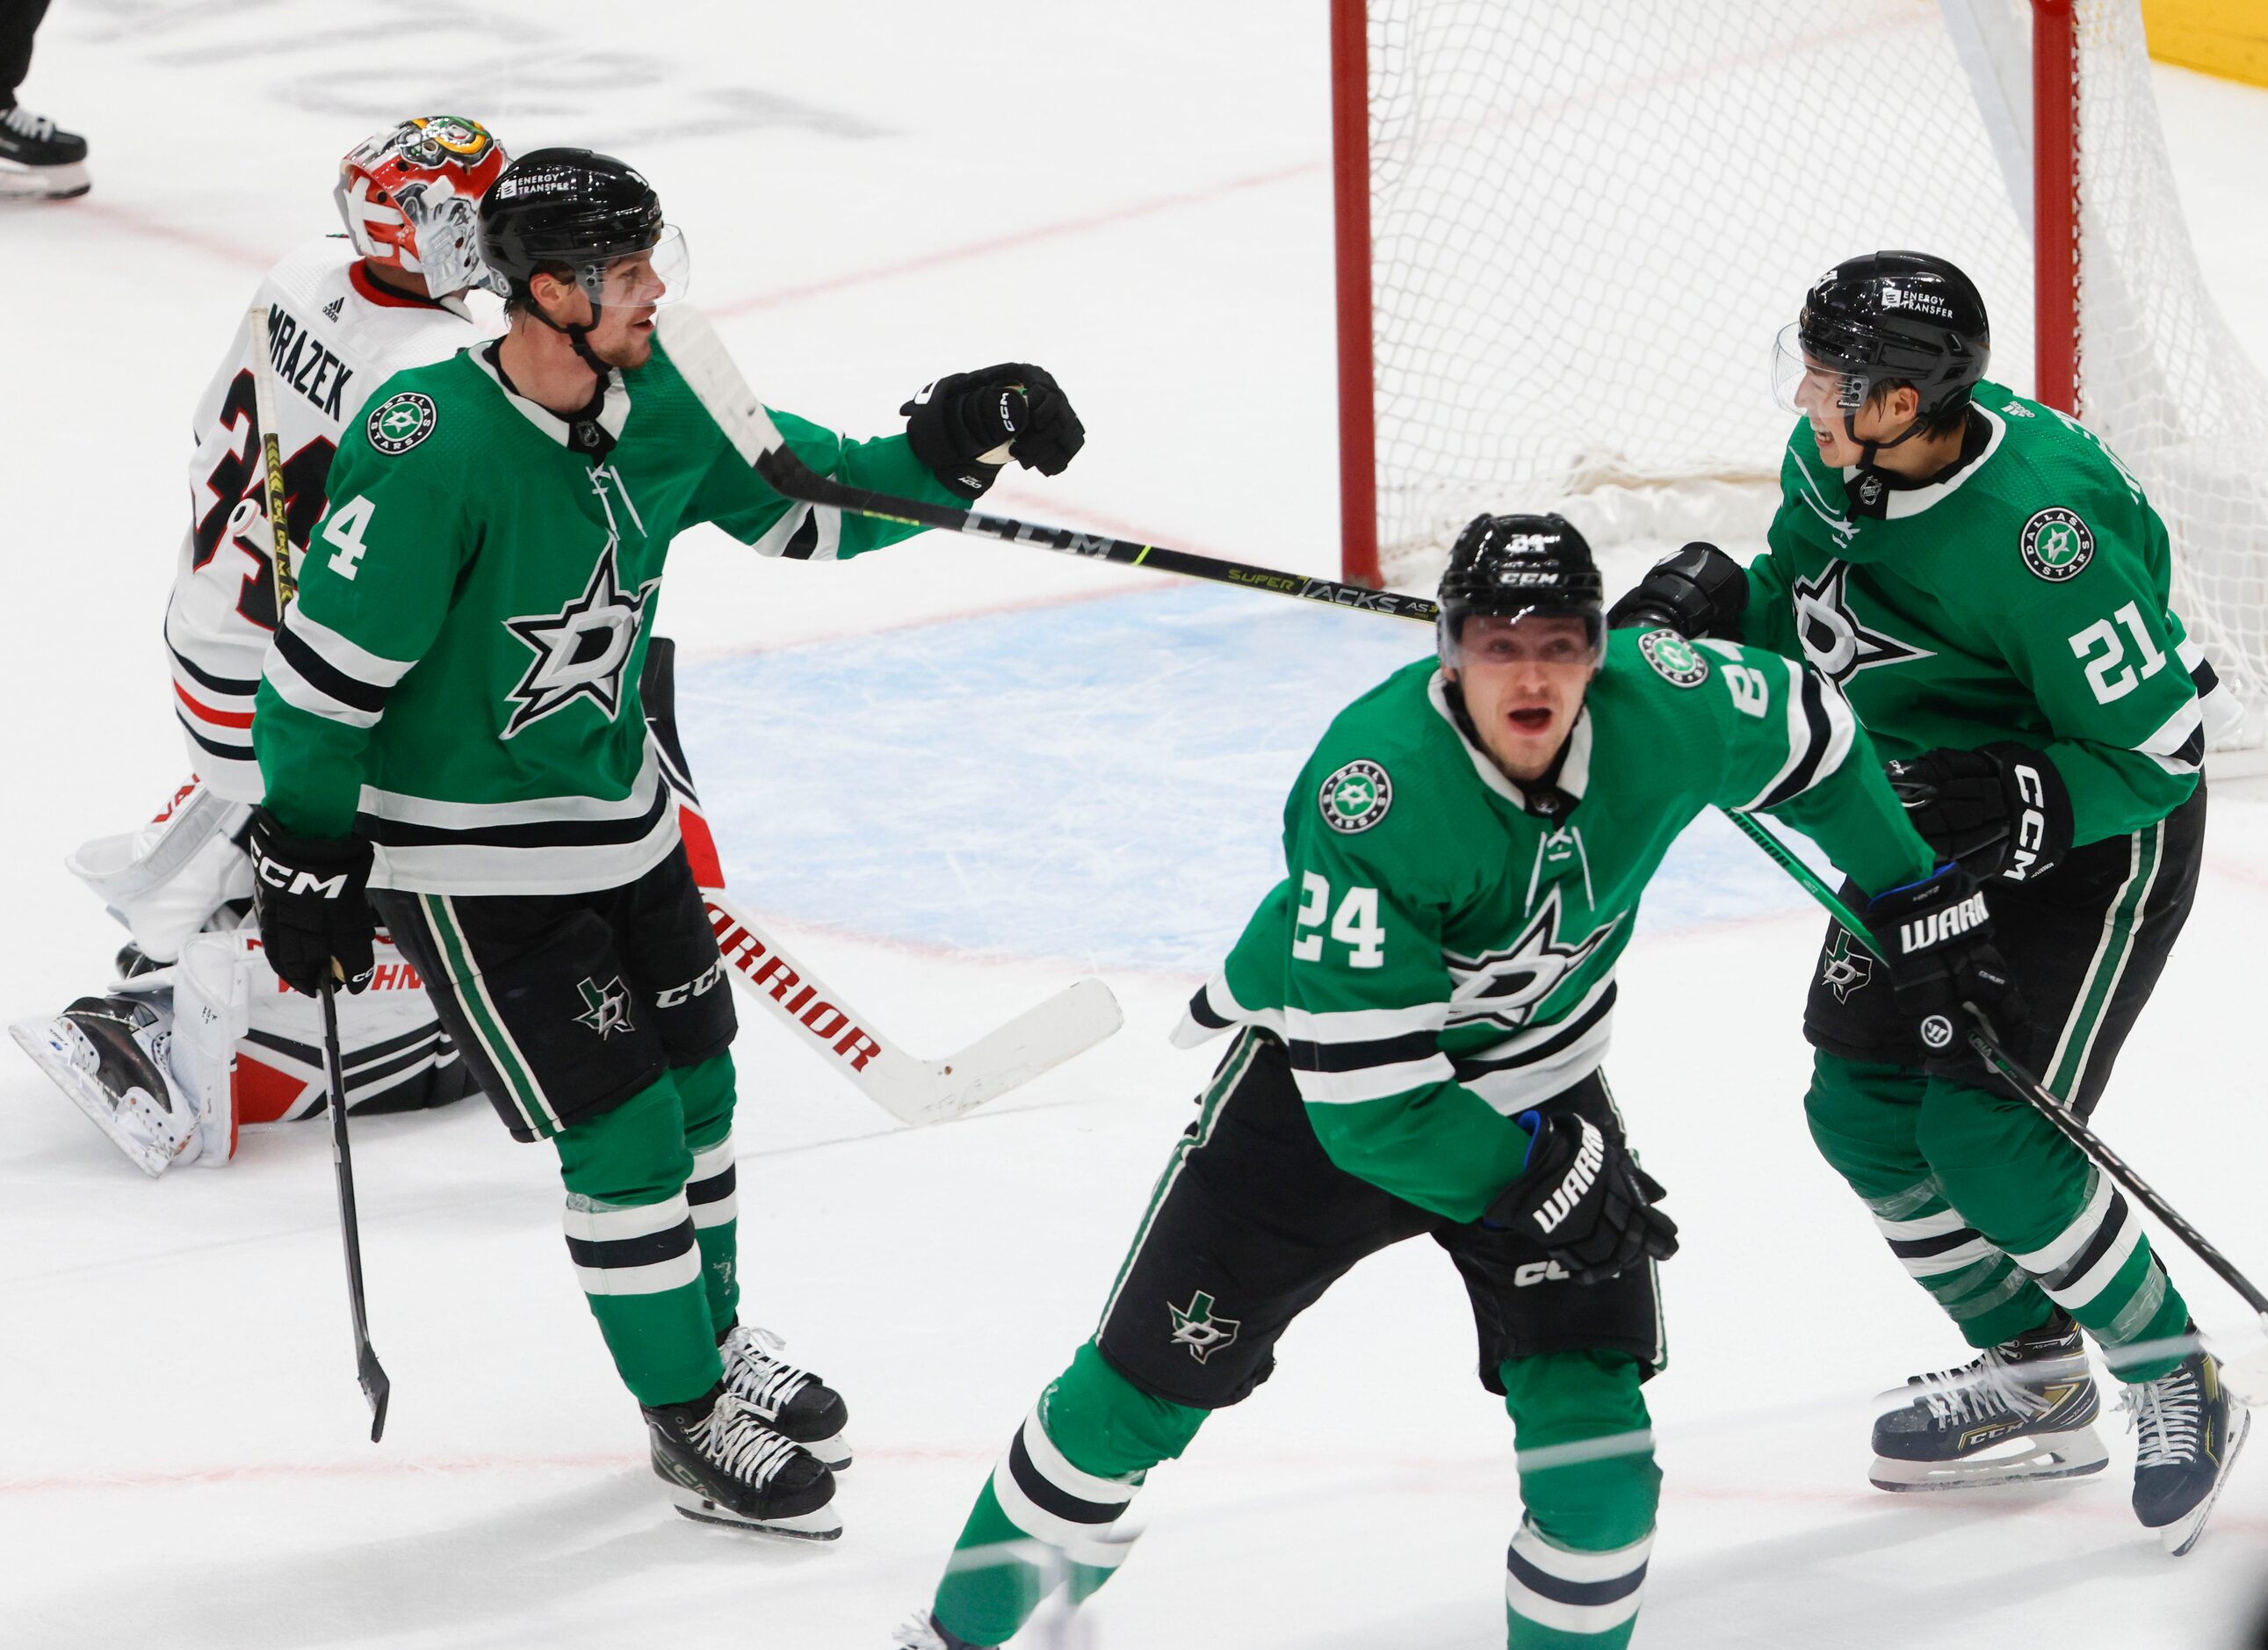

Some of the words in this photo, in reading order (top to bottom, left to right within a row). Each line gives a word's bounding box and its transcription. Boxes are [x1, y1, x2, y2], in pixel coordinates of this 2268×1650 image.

[517, 181, 569, 195] TRANSFER
[518, 173, 560, 185] ENERGY
[1902, 300, 1953, 319] TRANSFER
[1903, 290, 1945, 307] ENERGY
[267, 302, 353, 423] MRAZEK
[384, 395, 431, 427] DALLAS
[1000, 392, 1015, 432] CCM
[371, 422, 414, 450] STARS
[321, 494, 376, 582] 4
[2026, 512, 2078, 555] DALLAS
[2042, 540, 2090, 576] STARS
[1227, 568, 1295, 591] SUPER
[1297, 575, 1400, 613] TACKS
[1498, 572, 1559, 586] CCM
[2067, 599, 2167, 706] 21
[1723, 807, 1791, 868] ARRIOR
[2003, 763, 2045, 881] CCM
[249, 836, 348, 899] CCM
[1292, 870, 1386, 968] 24
[352, 967, 374, 983] CC
[704, 902, 882, 1074] ARRIOR
[1514, 1259, 1571, 1288] CC
[1969, 1421, 2025, 1445] CCM
